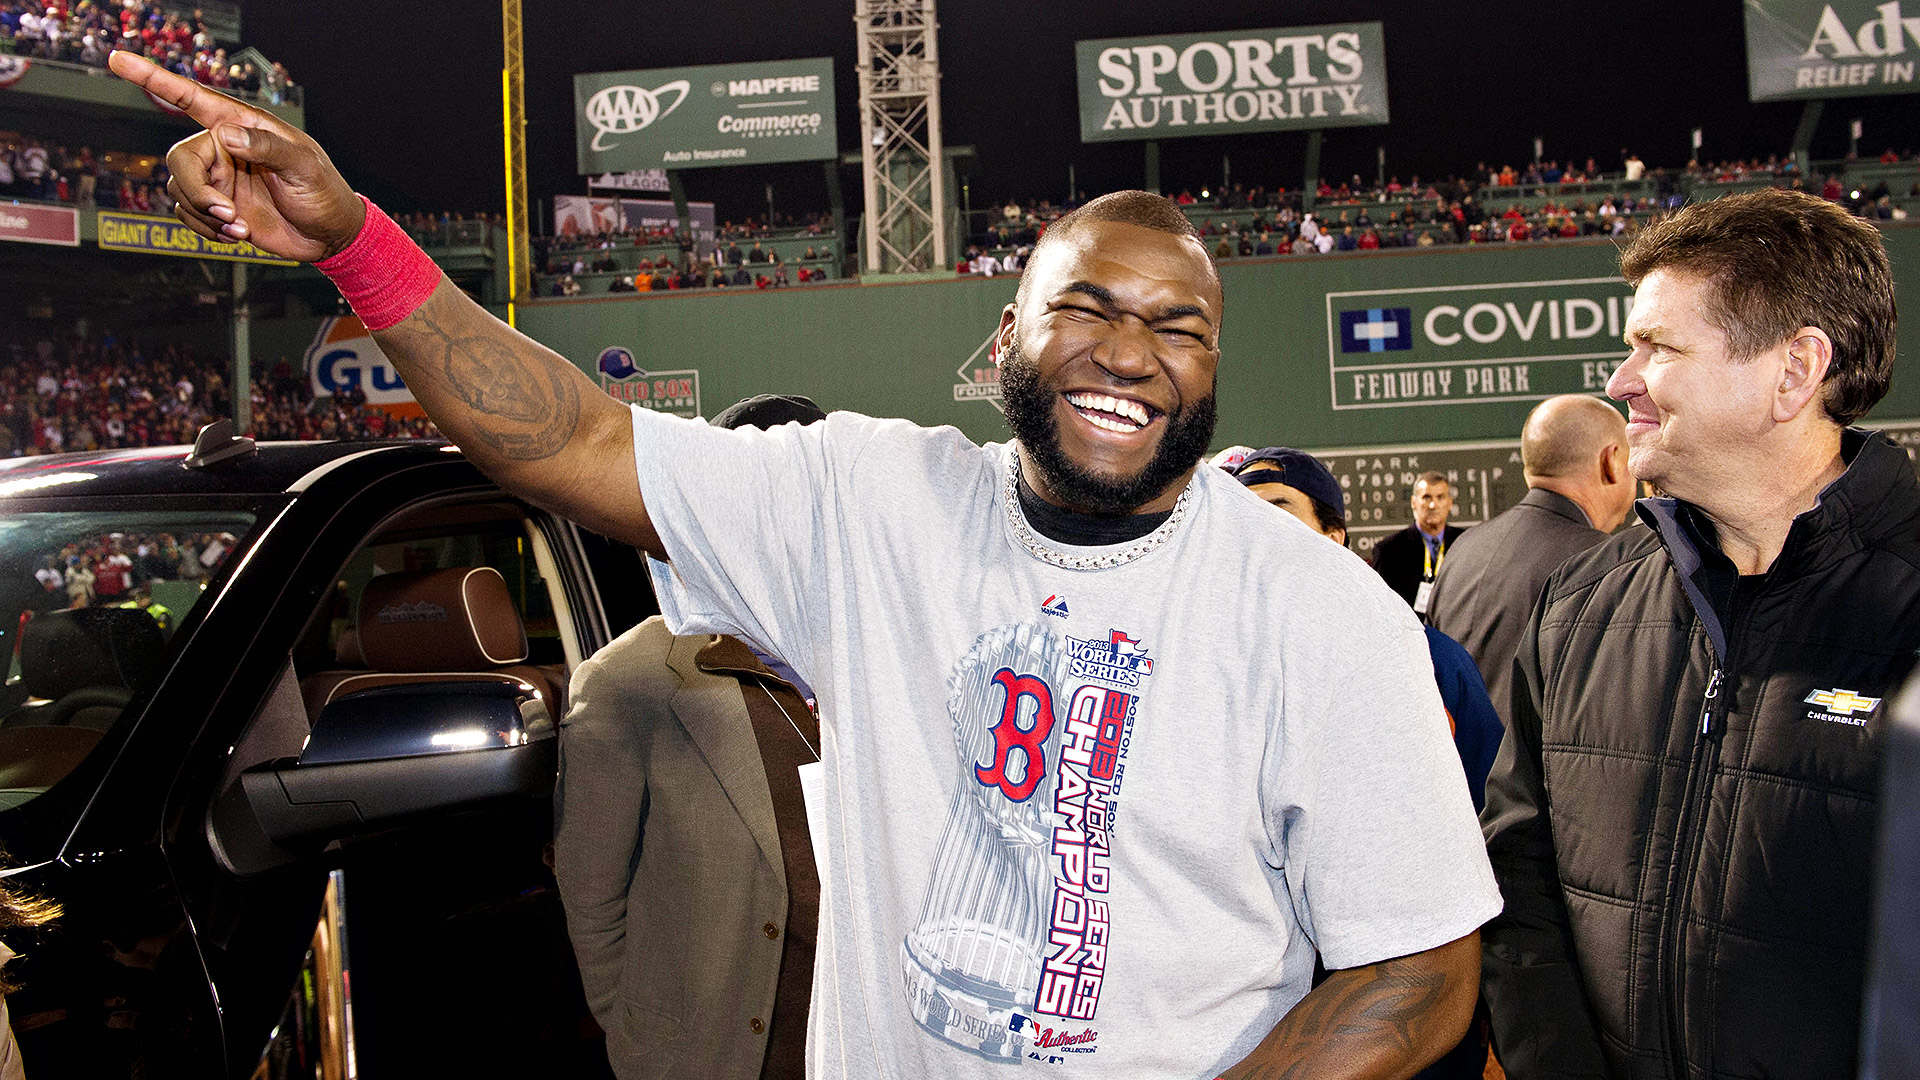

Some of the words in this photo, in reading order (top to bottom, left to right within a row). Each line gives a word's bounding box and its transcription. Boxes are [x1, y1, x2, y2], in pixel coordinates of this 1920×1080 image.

[1098, 32, 1363, 97] SPORTS
[1796, 63, 1877, 88] RELIEF
[1882, 61, 1915, 84] IN
[729, 75, 820, 97] MAPFRE
[596, 87, 650, 132] AAA
[1102, 84, 1362, 130] AUTHORITY
[717, 113, 821, 133] Commerce
[663, 150, 692, 163] Auto
[693, 148, 748, 160] Insurance
[104, 220, 147, 246] GIANT
[150, 223, 200, 251] GLASS
[609, 381, 649, 401] RED
[653, 378, 693, 400] SOX
[1354, 369, 1453, 400] FENWAY
[1465, 366, 1530, 394] PARK
[1355, 456, 1420, 471] PARK
[1340, 474, 1351, 489] 6
[1358, 473, 1367, 487] 7
[1041, 606, 1070, 620] Majestic
[1066, 638, 1130, 668] WORLD
[1088, 639, 1110, 651] 2013
[1069, 658, 1140, 686] SERIES
[1117, 695, 1140, 760] BOSTON
[1807, 711, 1867, 727] CHEVROLET
[975, 667, 1056, 804] B
[1087, 690, 1131, 781] 2013
[1112, 763, 1126, 796] RED
[1107, 800, 1118, 832] SOX
[1033, 684, 1108, 1016] CHAMPIONS
[1084, 780, 1112, 894] WORLD
[1070, 897, 1111, 1020] SERIES
[963, 1014, 1008, 1045] SERIES
[1033, 1027, 1099, 1049] Authentic
